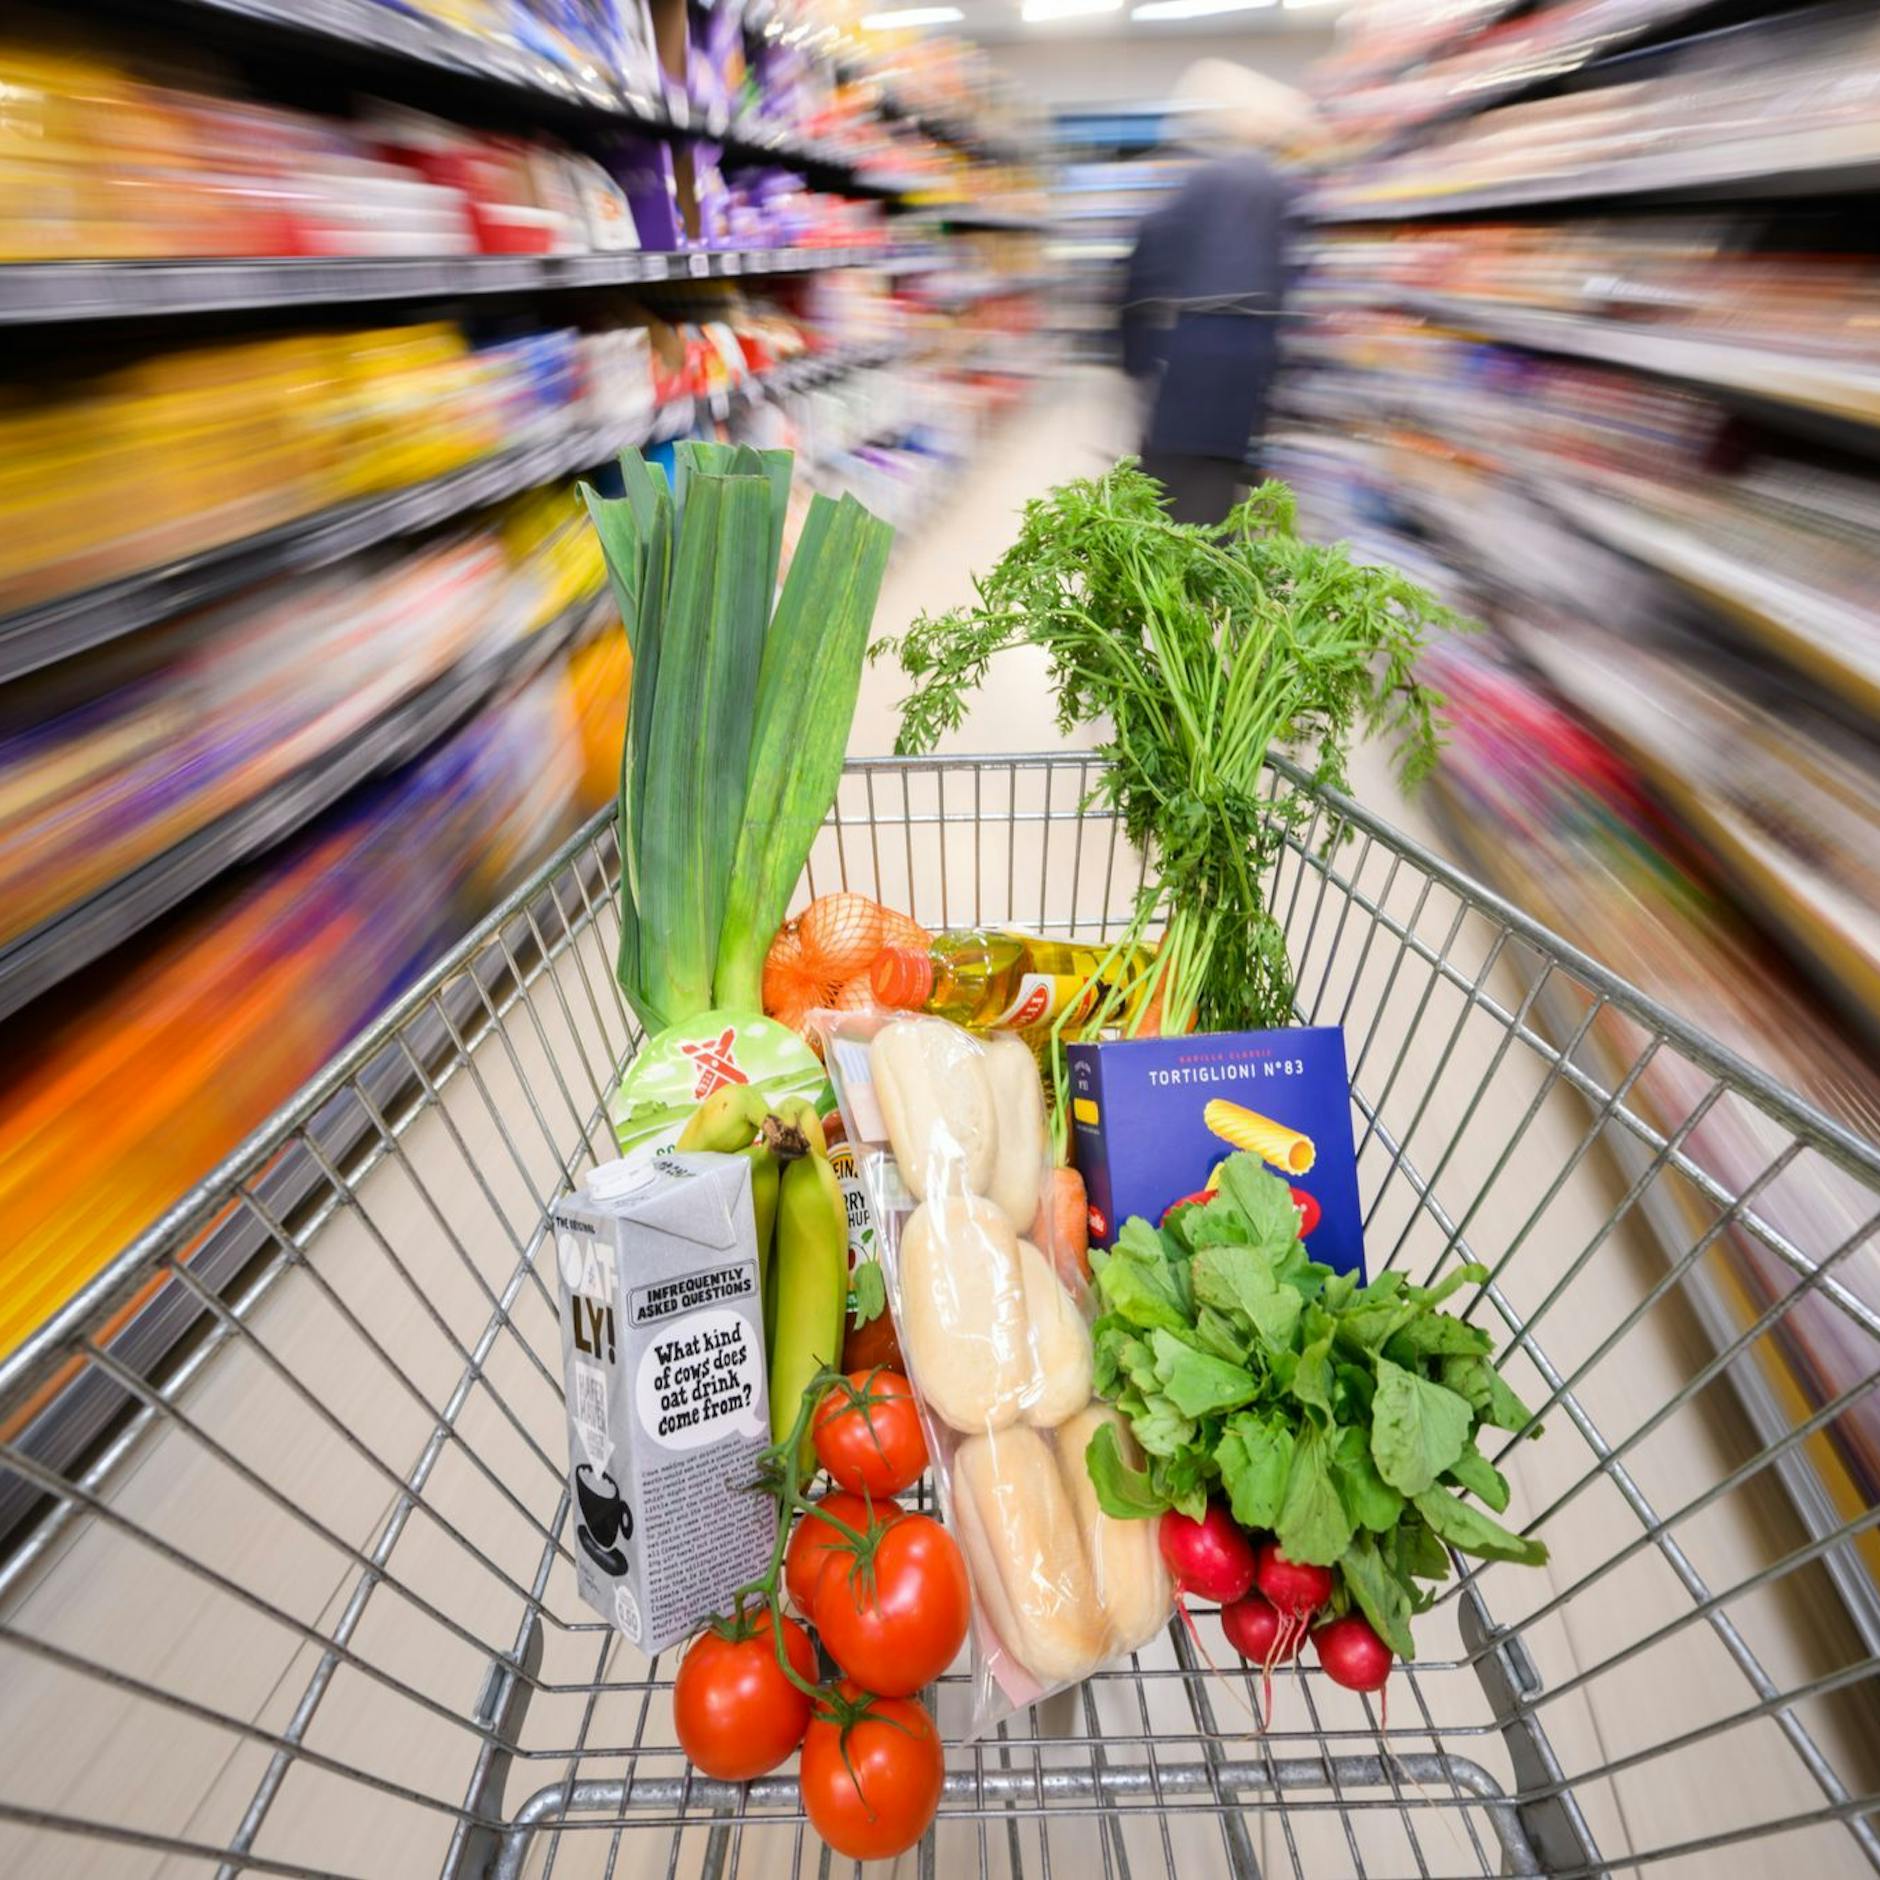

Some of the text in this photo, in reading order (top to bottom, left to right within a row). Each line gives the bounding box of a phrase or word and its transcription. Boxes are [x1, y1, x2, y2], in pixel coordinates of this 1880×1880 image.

[1148, 1063, 1256, 1087] TORTIGLIONI
[833, 1159, 859, 1179] EIN
[637, 1278, 753, 1321] ASKED QUESTIONS
[647, 1268, 744, 1304] INFREQUENTLY
[572, 1294, 616, 1365] LY!
[654, 1321, 742, 1366] What kind
[654, 1346, 748, 1391] of cows does
[658, 1383, 753, 1437] come from?
[660, 1371, 741, 1411] oat drink
